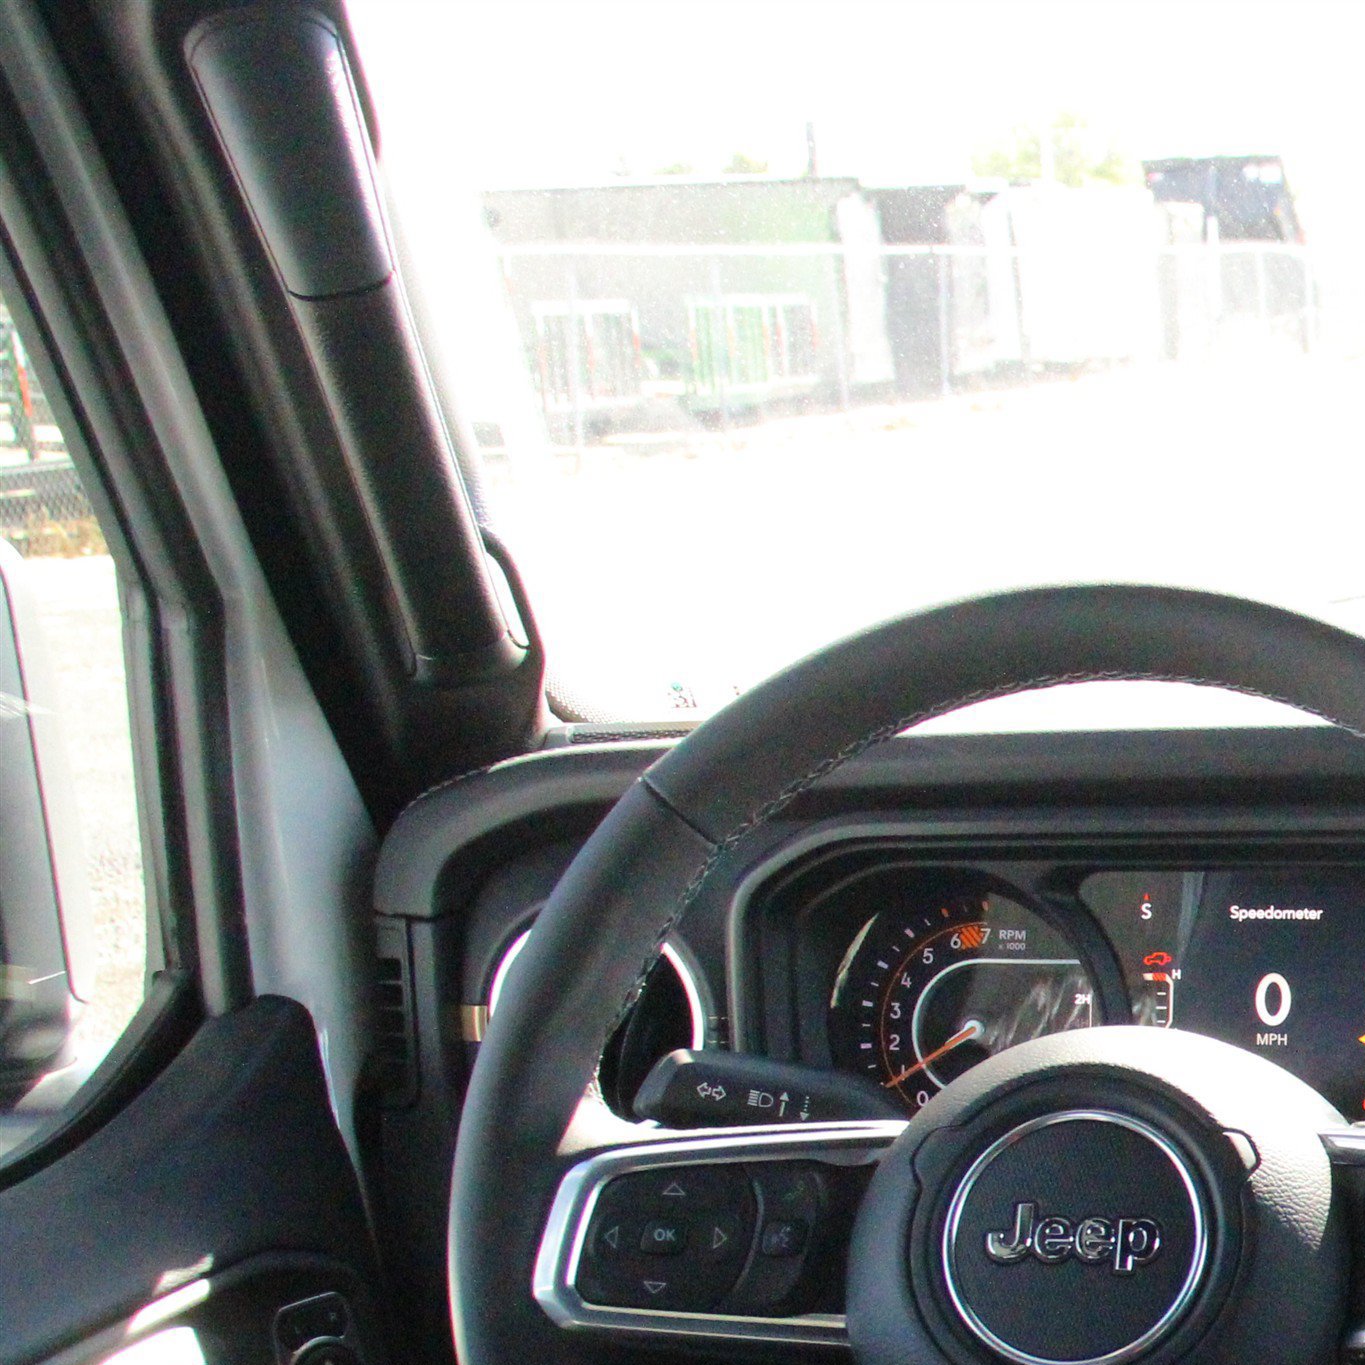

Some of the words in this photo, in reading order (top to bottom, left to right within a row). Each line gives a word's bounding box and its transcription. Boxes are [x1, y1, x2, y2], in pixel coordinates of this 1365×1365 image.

[1141, 903, 1151, 919] S
[1230, 905, 1322, 921] Speedometer
[949, 933, 960, 950] 6
[999, 929, 1026, 941] RPM
[1006, 942, 1026, 951] 1000
[922, 947, 933, 965] 5
[901, 971, 912, 989] 4
[1171, 969, 1181, 980] H
[1255, 973, 1291, 1026] 0
[889, 1002, 901, 1020] 3
[889, 1034, 900, 1052] 2
[1256, 1033, 1288, 1046] MPH
[916, 1090, 929, 1108] 0
[653, 1228, 676, 1242] OK
[986, 1202, 1161, 1272] Jeep
